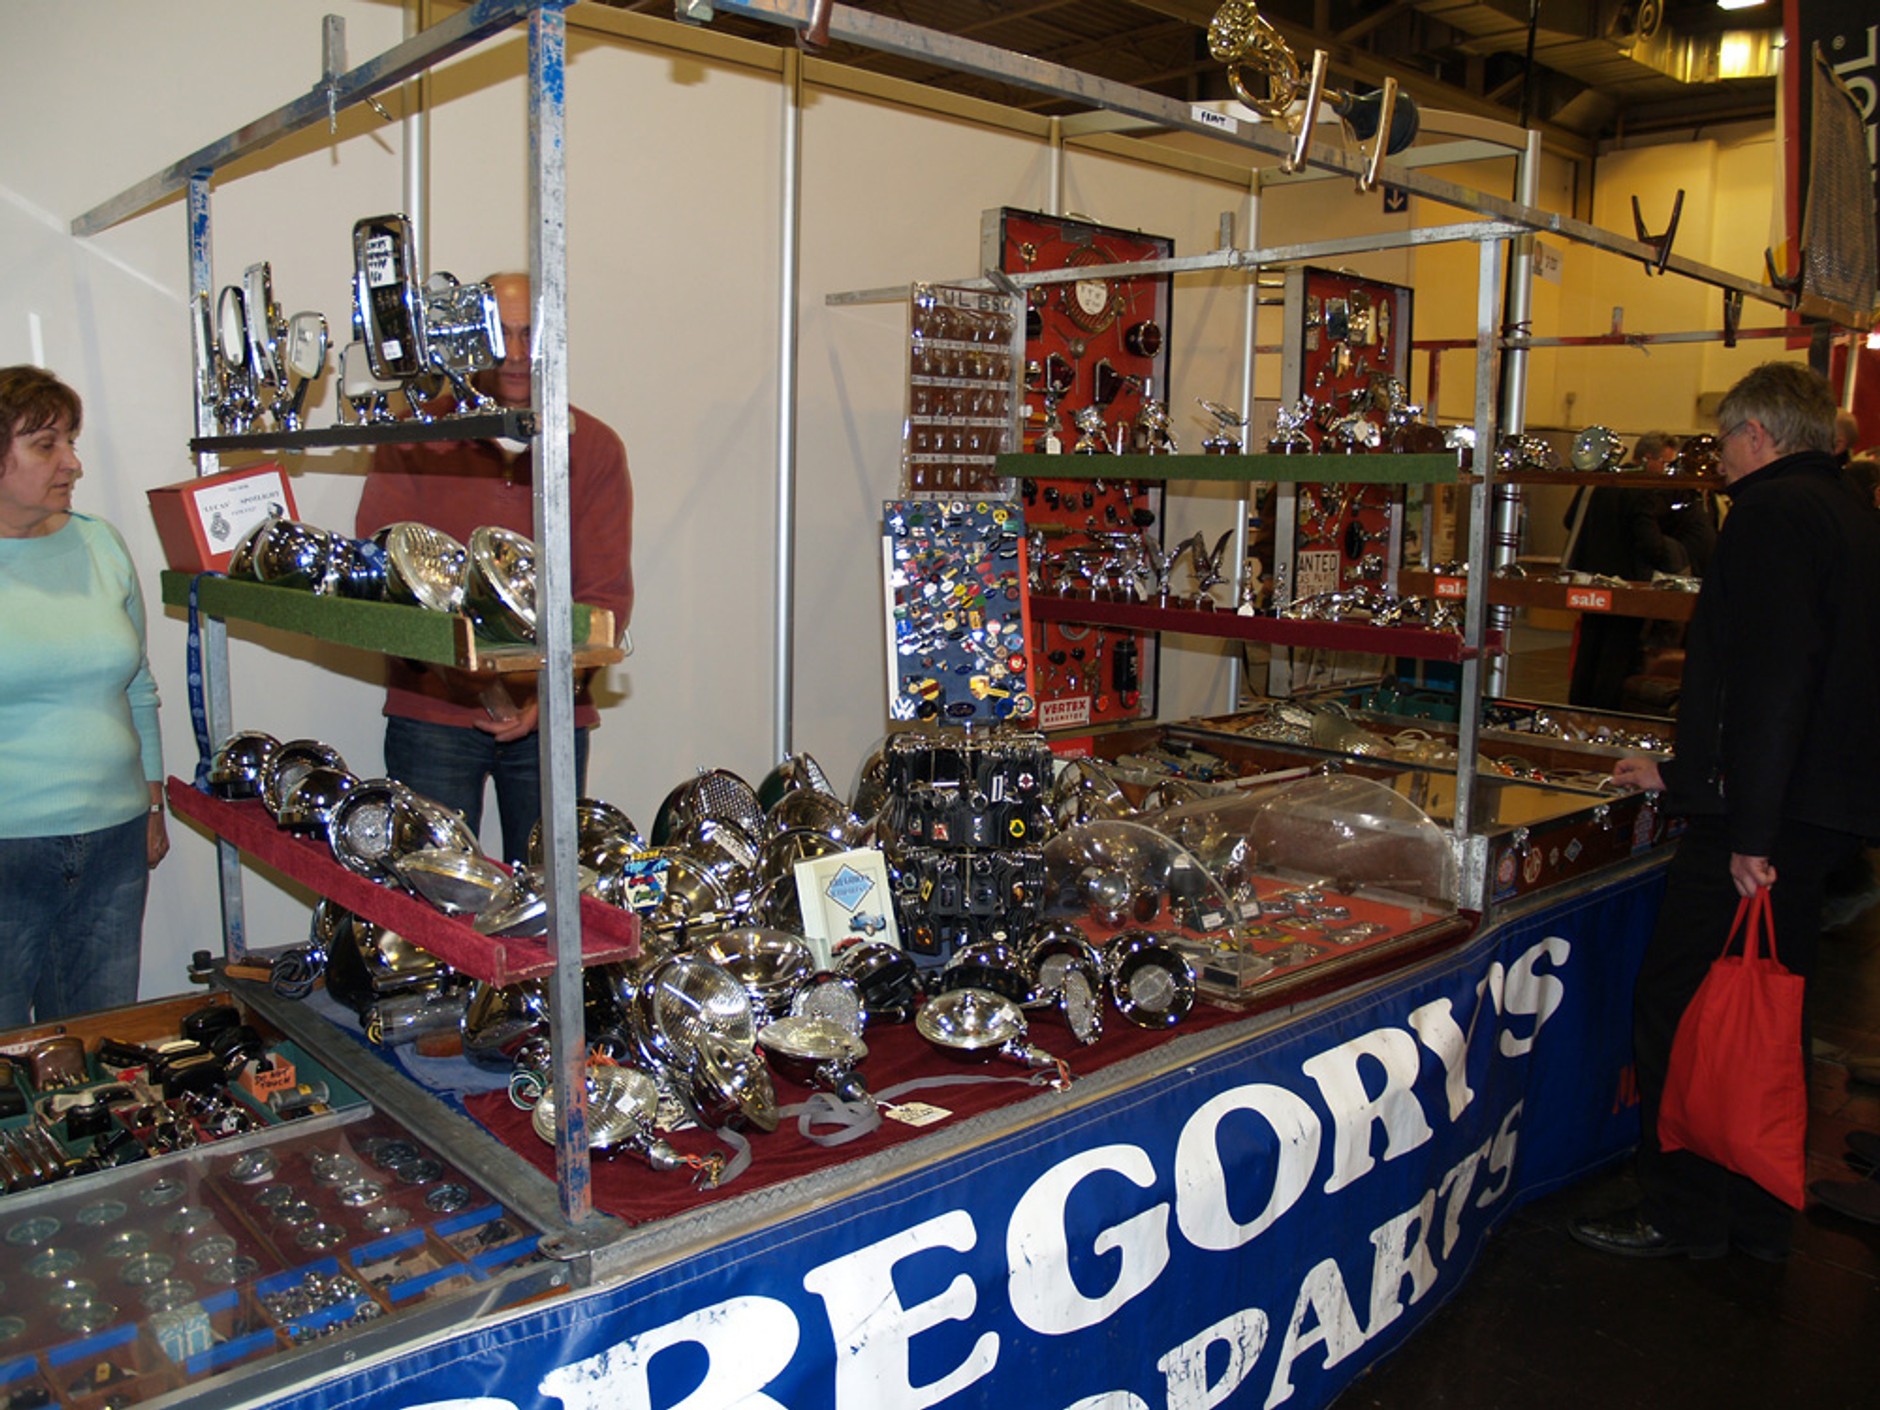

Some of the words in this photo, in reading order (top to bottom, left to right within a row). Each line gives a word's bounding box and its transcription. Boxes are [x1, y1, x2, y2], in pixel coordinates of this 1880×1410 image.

[1297, 553, 1338, 572] ANTED
[1571, 592, 1606, 608] sale
[1044, 700, 1086, 715] VERTEX
[388, 936, 1571, 1410] REGORY'S
